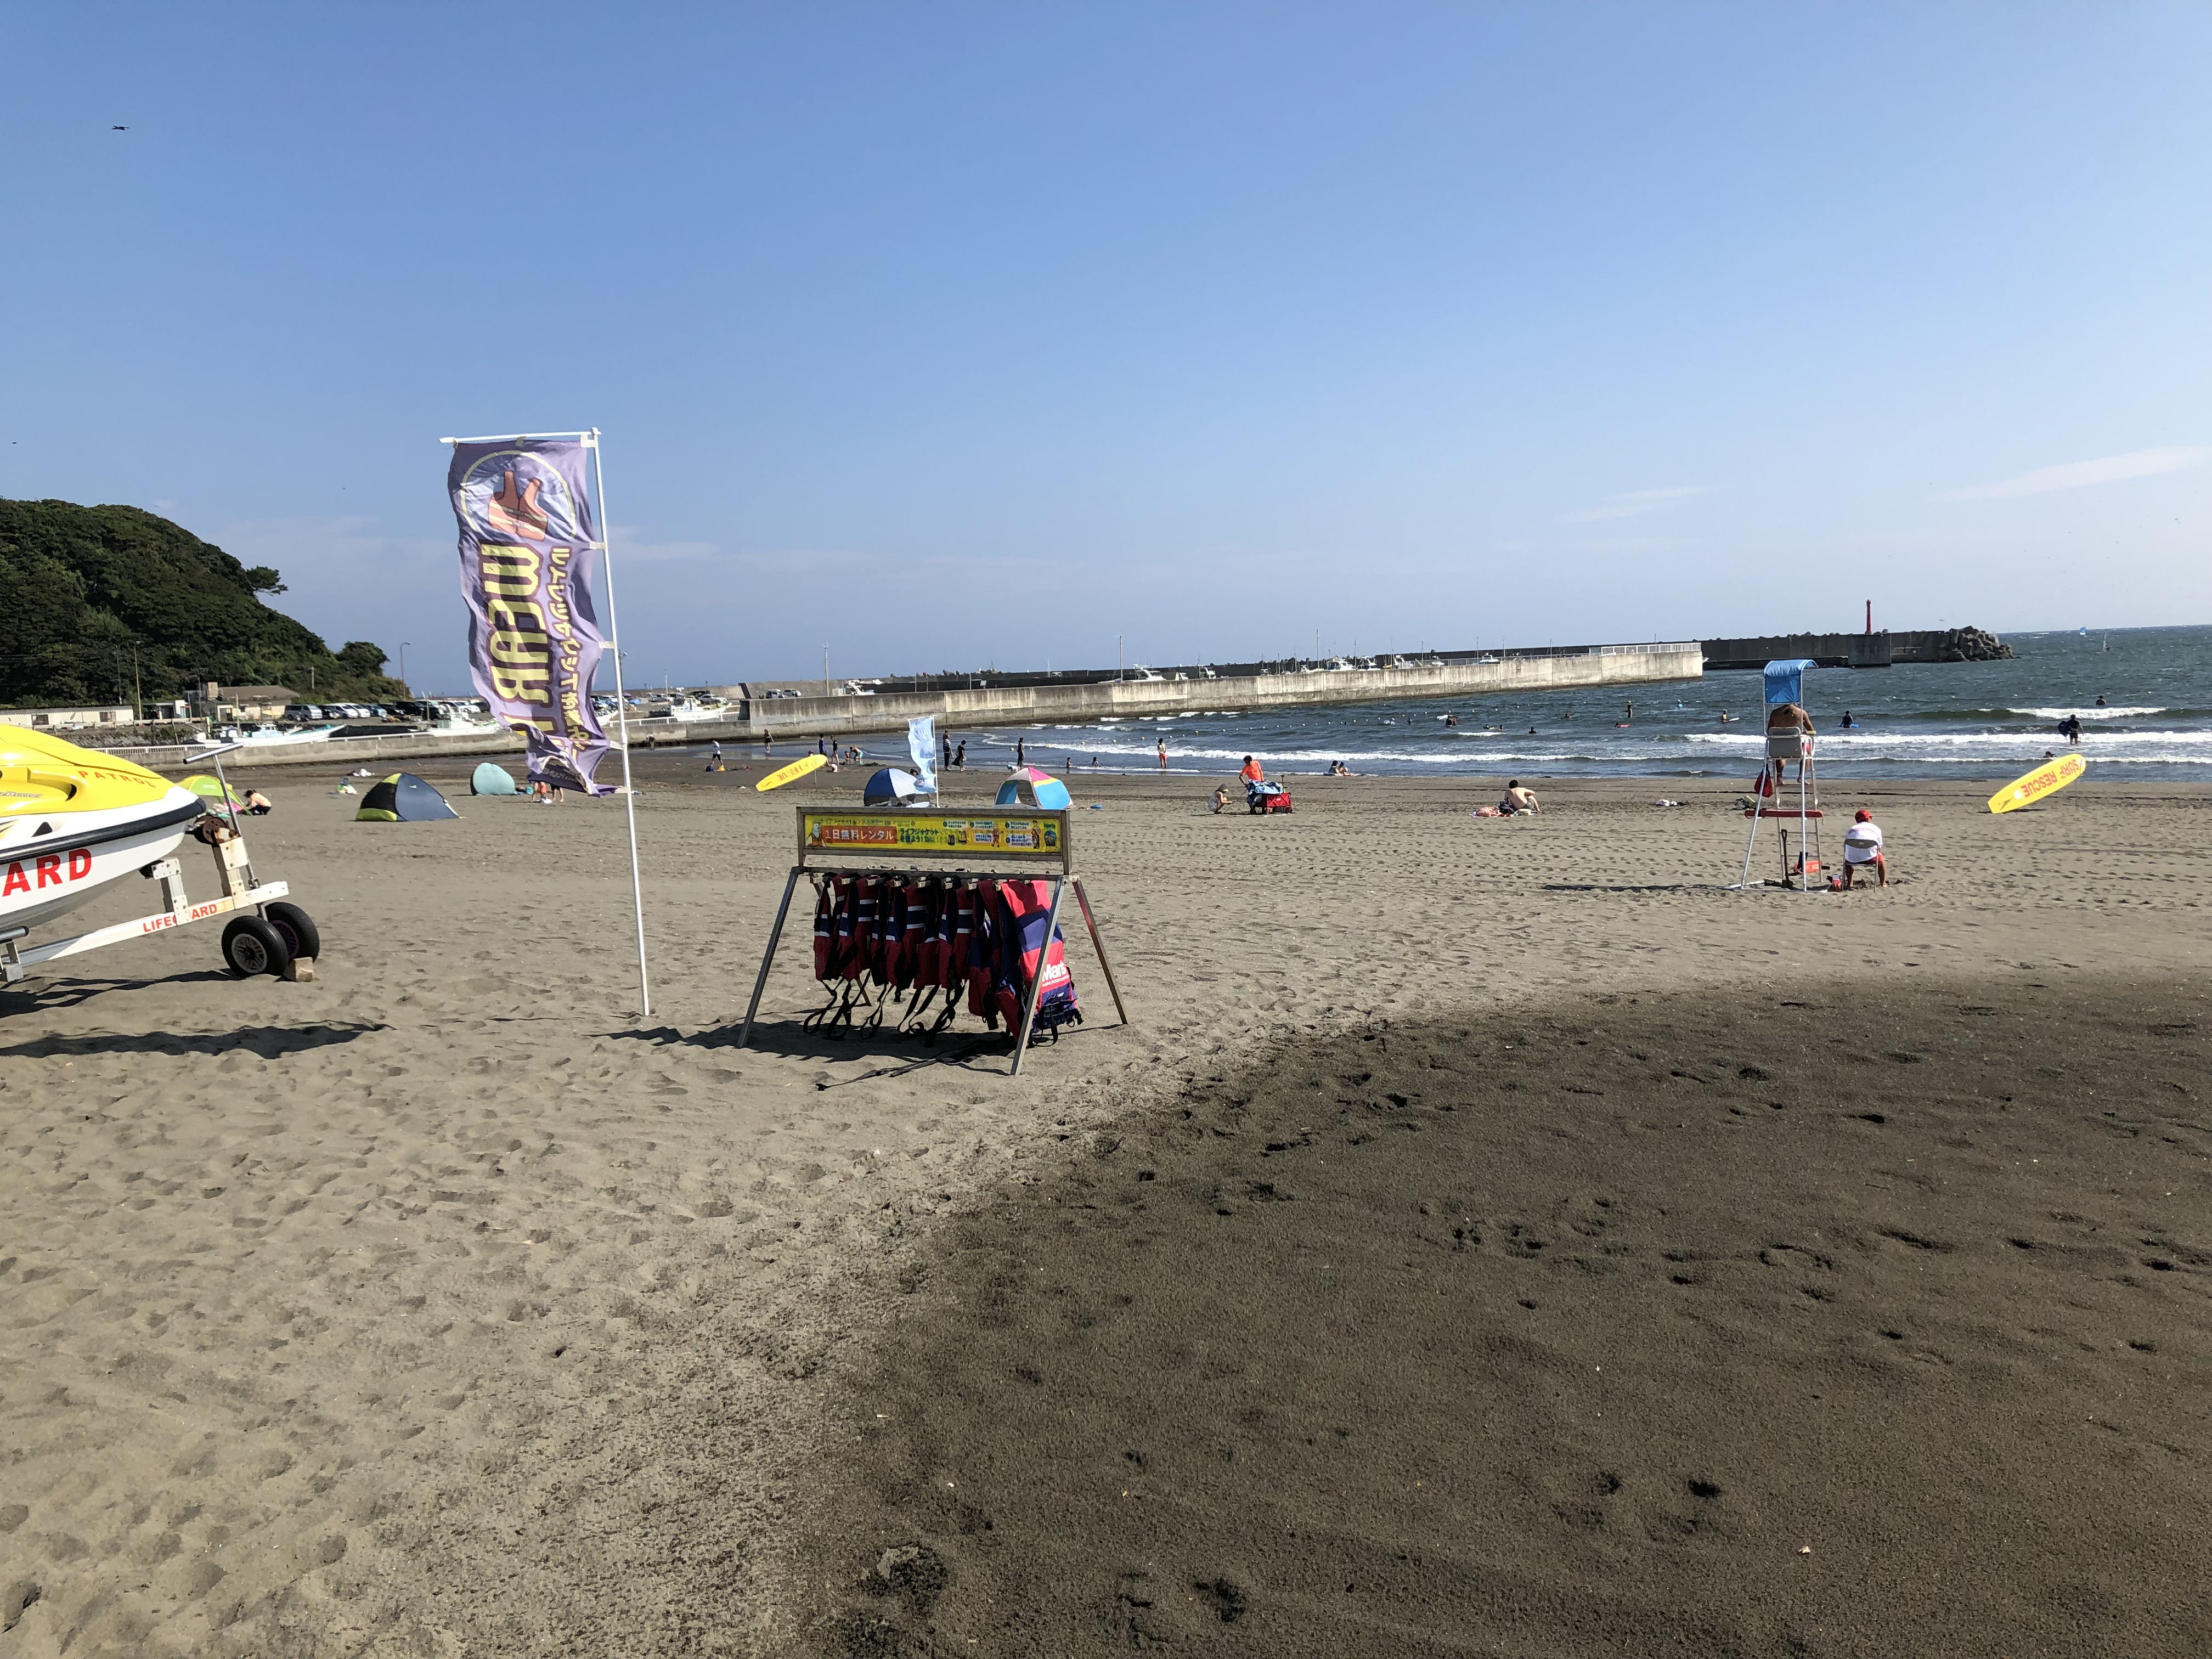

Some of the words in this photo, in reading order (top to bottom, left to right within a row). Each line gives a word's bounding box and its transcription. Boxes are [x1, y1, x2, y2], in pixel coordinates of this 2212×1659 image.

[78, 771, 156, 788] PATROL
[2059, 759, 2079, 779] SURF
[2020, 770, 2058, 798] RESCUE
[825, 830, 894, 840] 1日無料レンタル
[2, 848, 92, 897] ARD
[143, 904, 218, 933] LIFEARD
